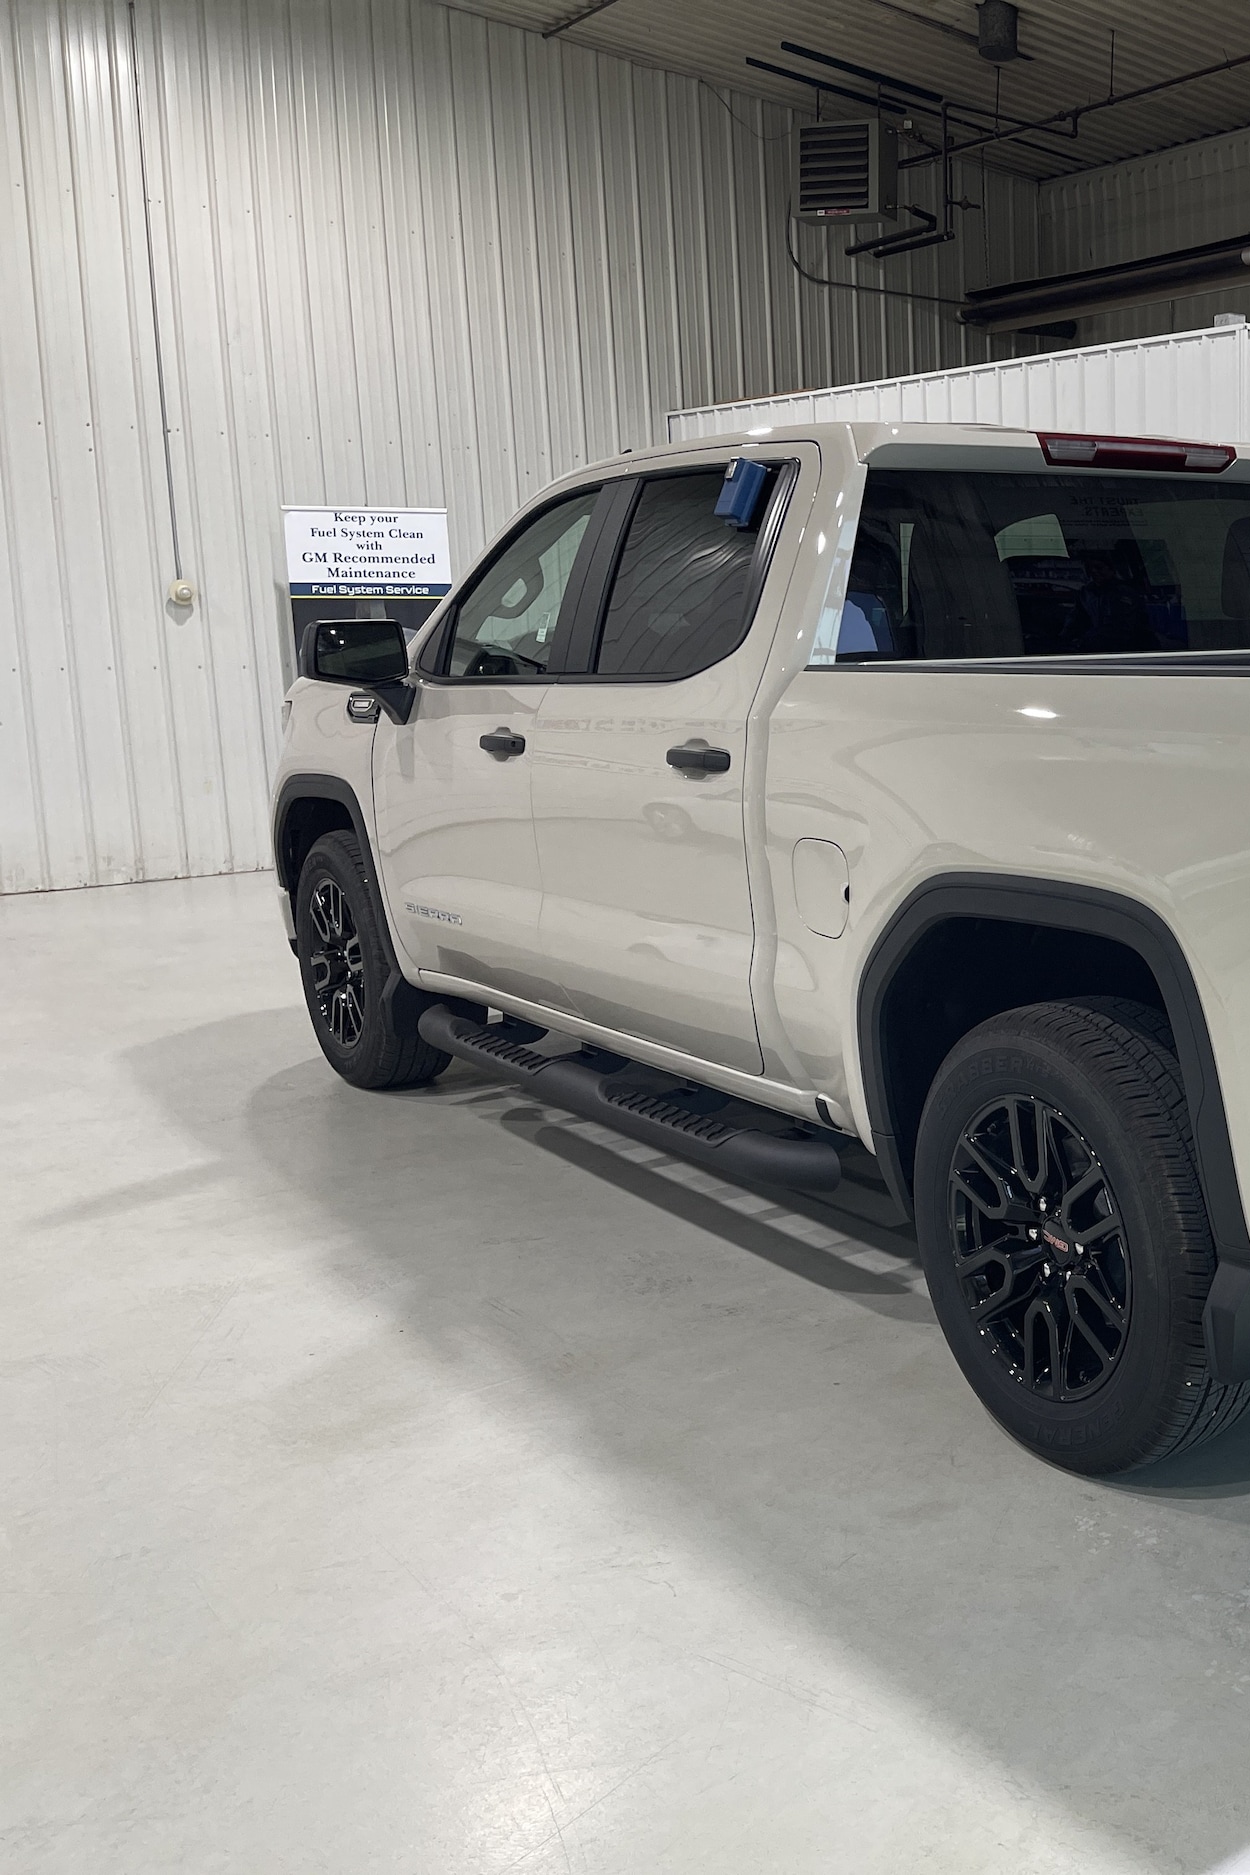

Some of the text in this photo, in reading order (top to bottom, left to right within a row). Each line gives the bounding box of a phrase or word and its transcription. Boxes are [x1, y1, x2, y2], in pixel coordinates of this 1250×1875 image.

[333, 512, 399, 525] Keep your
[310, 527, 424, 541] Fuel System Clean
[356, 541, 383, 551] with
[302, 552, 436, 565] GM Recommended
[327, 567, 416, 579] Maintenance
[311, 585, 430, 596] Fuel System Service
[404, 902, 463, 925] SIERRA
[1042, 1228, 1069, 1253] GMC
